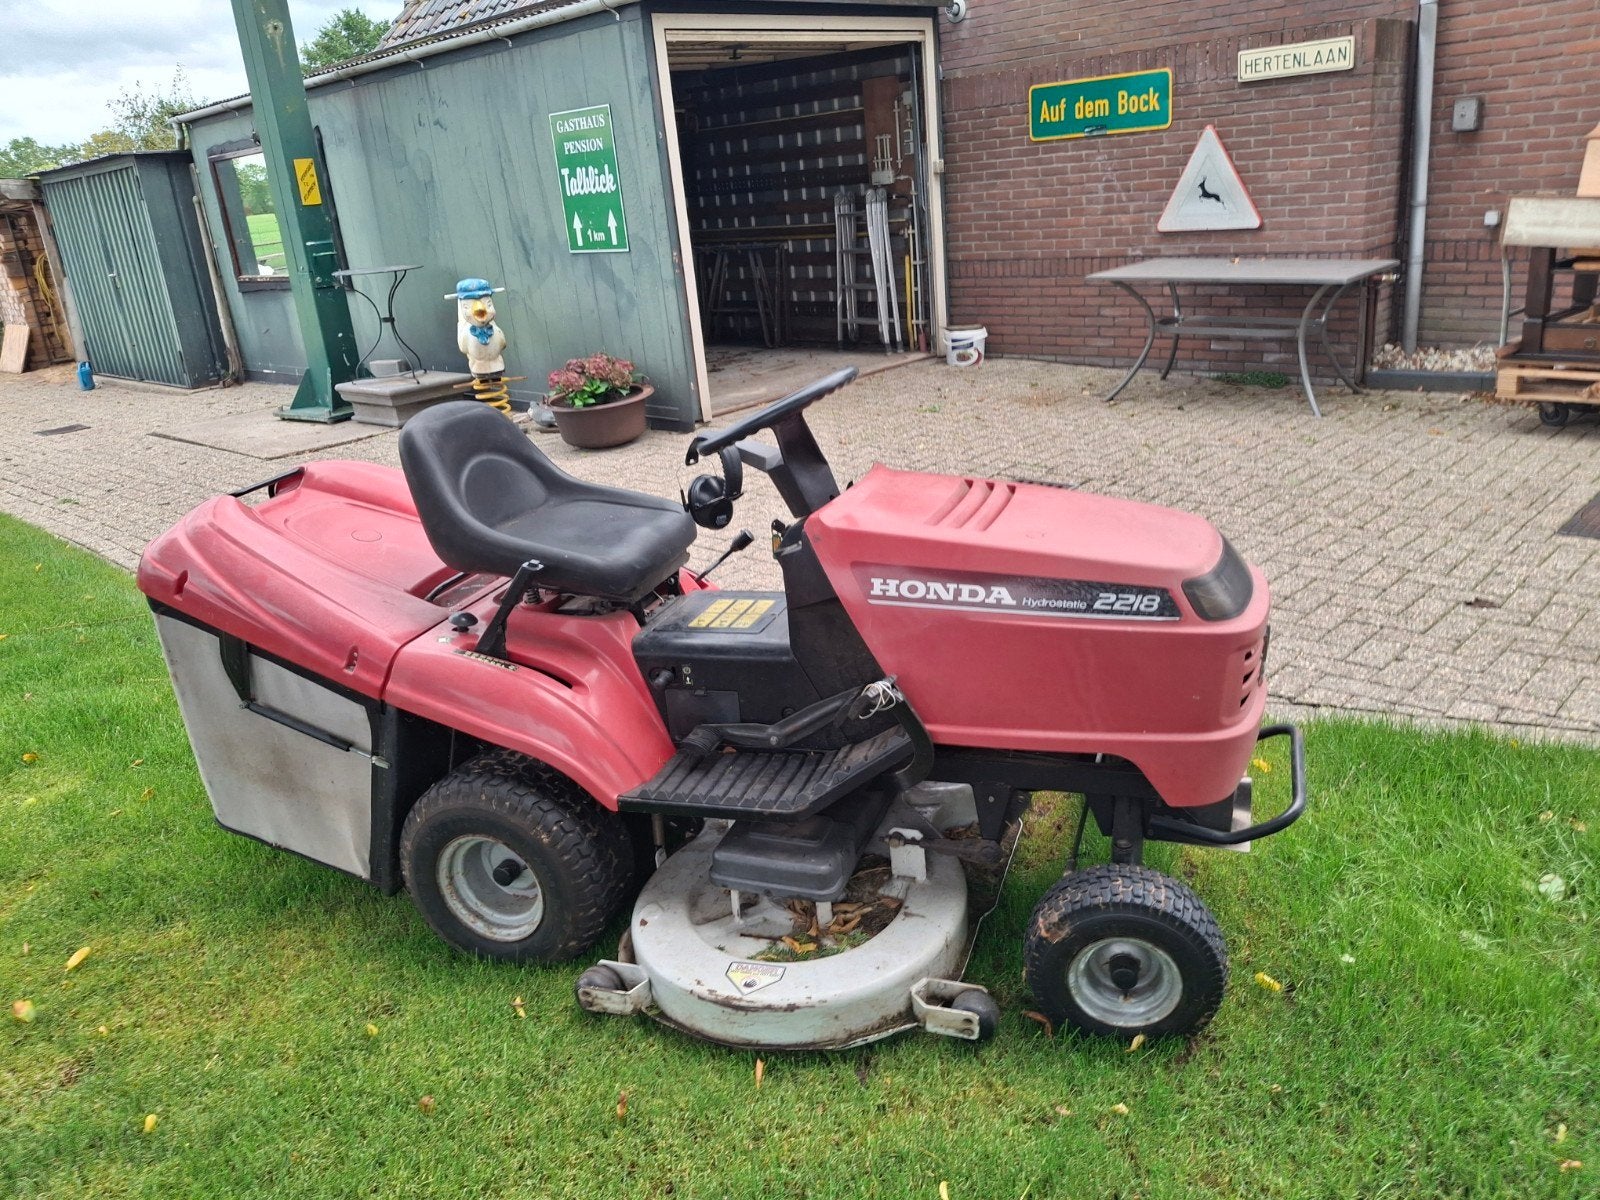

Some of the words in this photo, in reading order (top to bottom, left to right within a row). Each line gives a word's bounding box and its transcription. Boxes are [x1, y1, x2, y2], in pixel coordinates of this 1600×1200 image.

[1244, 46, 1347, 75] HERTENLAAN
[1040, 98, 1067, 123] Auf
[1075, 96, 1110, 120] dem
[1117, 86, 1160, 115] Bock
[556, 114, 606, 134] GASTHAUS
[563, 137, 604, 155] PENSION
[560, 163, 617, 197] Talblick
[587, 228, 593, 243] 1
[593, 230, 606, 242] km
[870, 577, 1016, 606] HONDA
[1092, 592, 1161, 613] 2218
